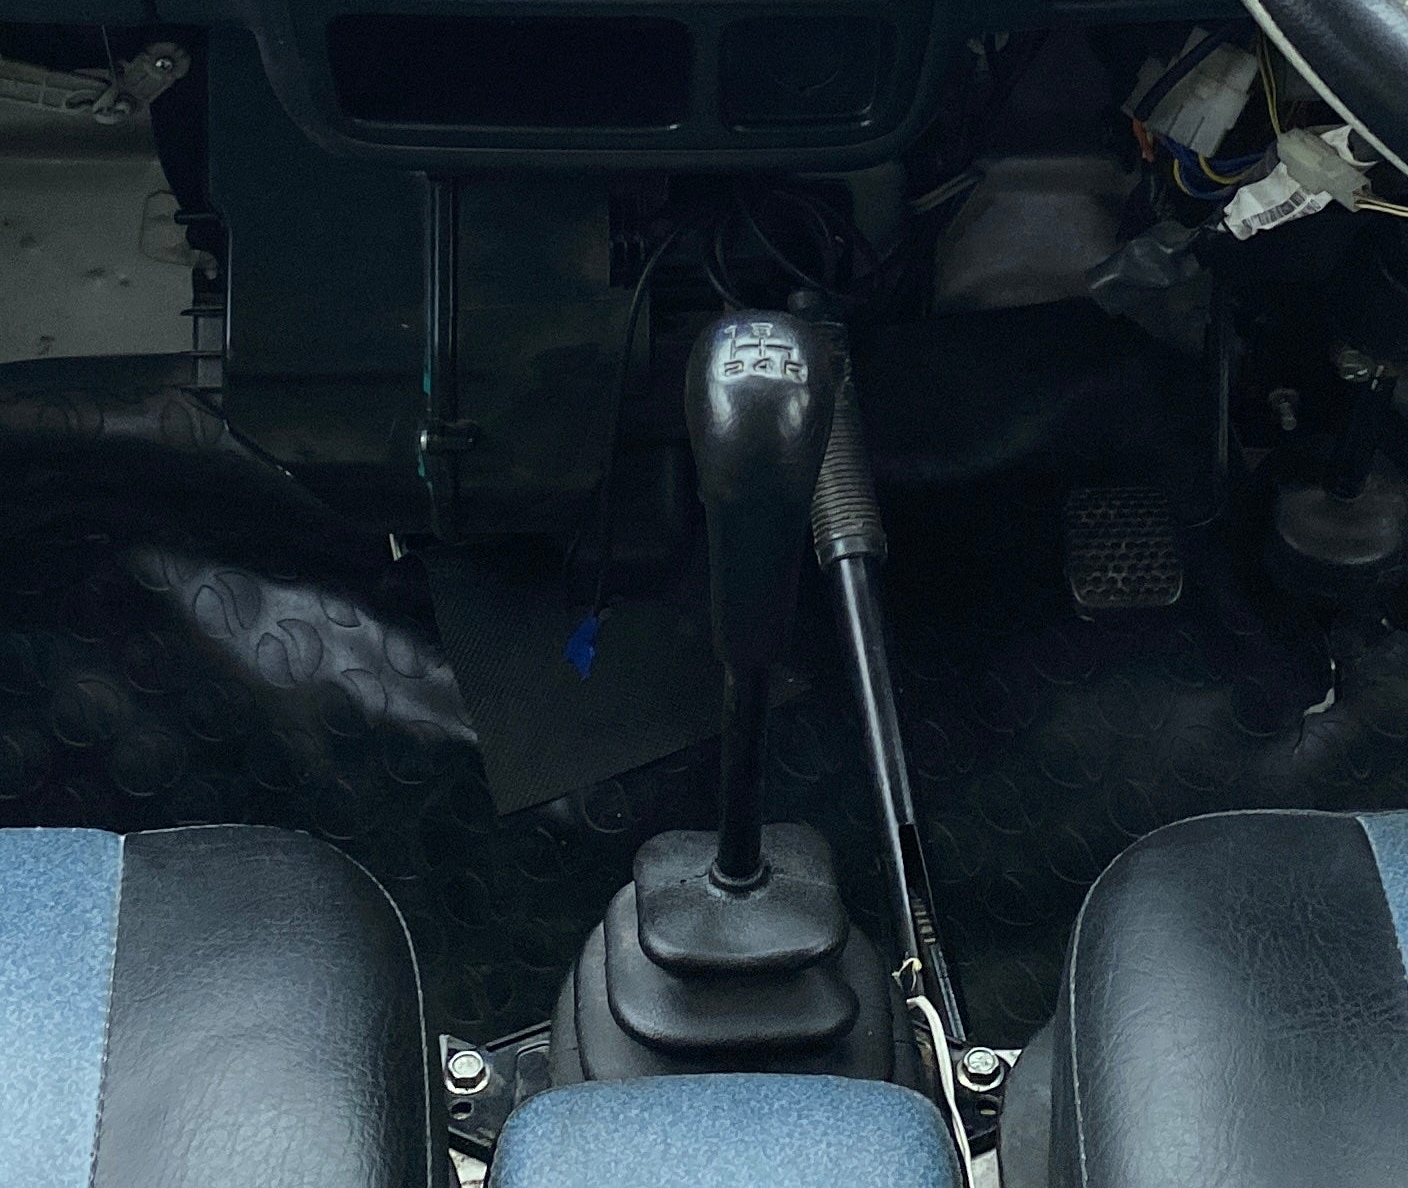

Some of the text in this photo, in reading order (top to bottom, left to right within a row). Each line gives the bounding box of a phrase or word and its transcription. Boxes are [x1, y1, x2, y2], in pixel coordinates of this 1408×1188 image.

[723, 357, 808, 383] 2 4 R
